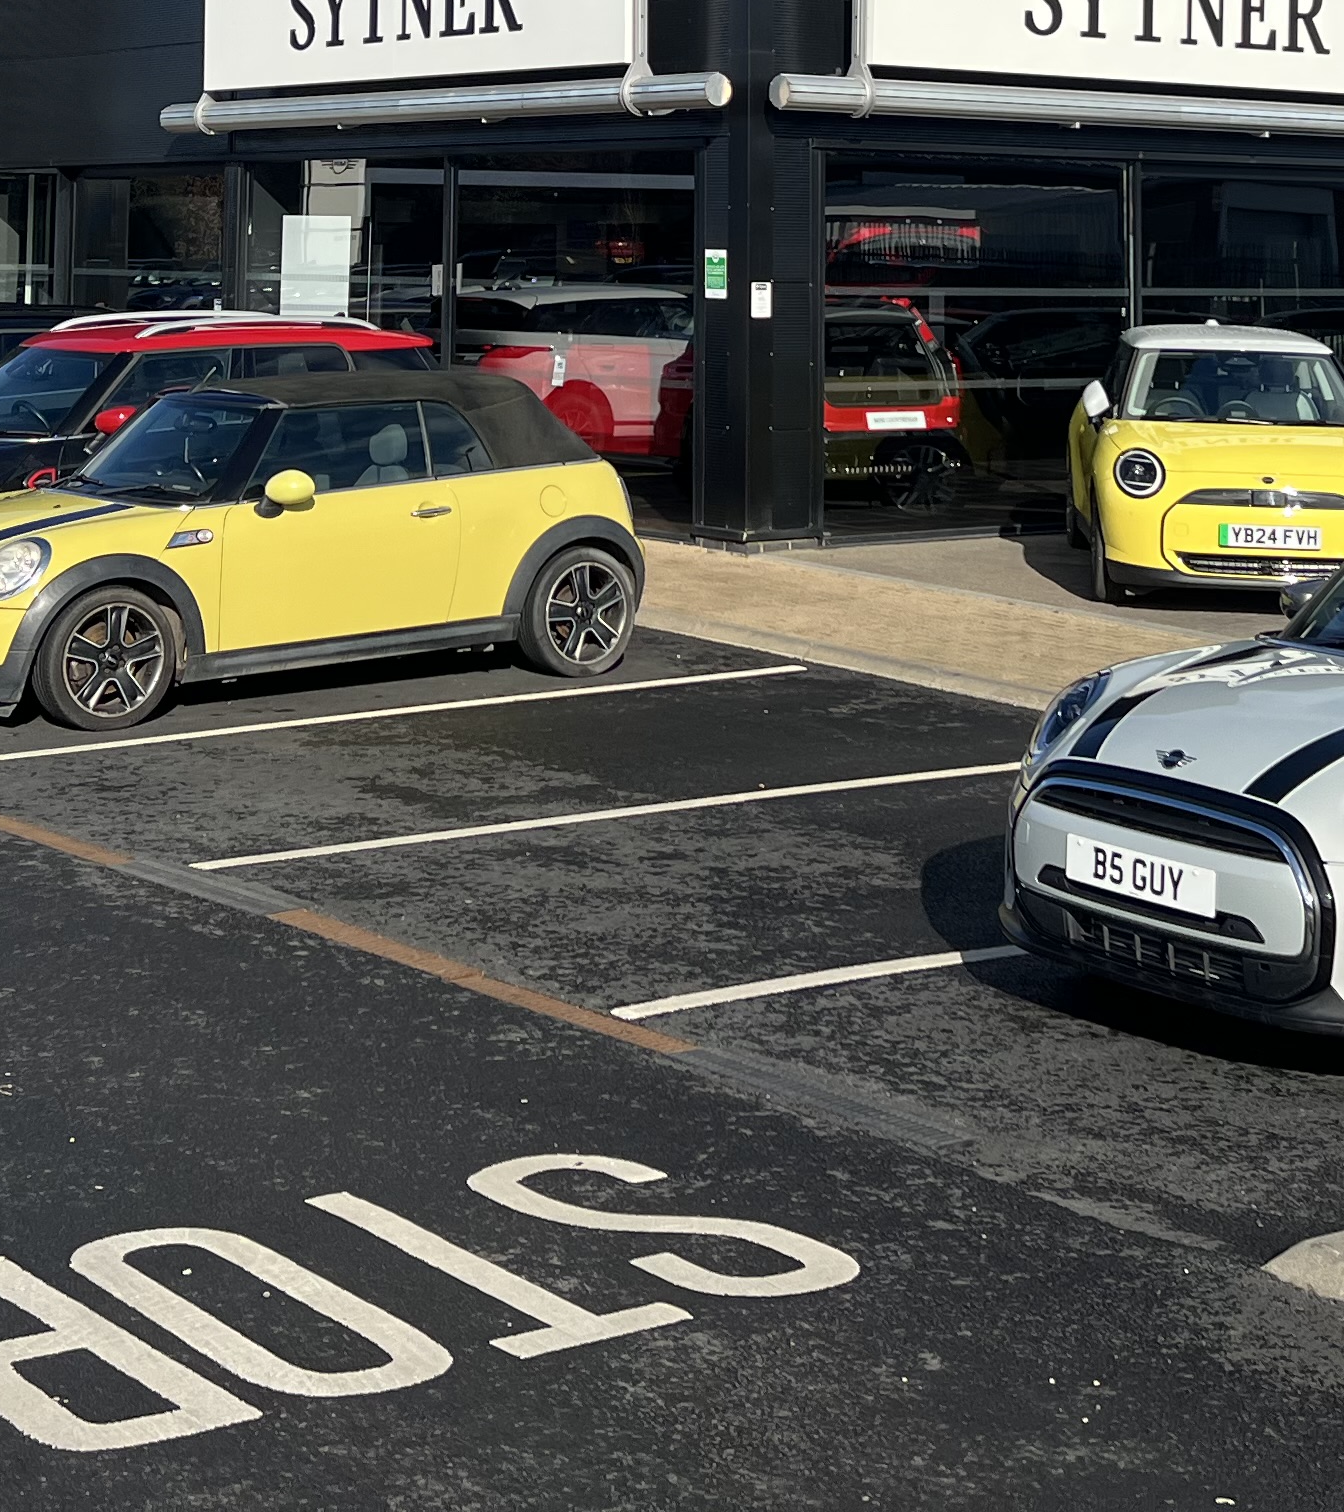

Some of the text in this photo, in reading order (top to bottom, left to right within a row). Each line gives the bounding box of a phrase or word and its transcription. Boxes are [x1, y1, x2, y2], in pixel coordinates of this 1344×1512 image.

[1231, 526, 1318, 546] YB24 FVH
[1093, 846, 1184, 901] B5 GUY
